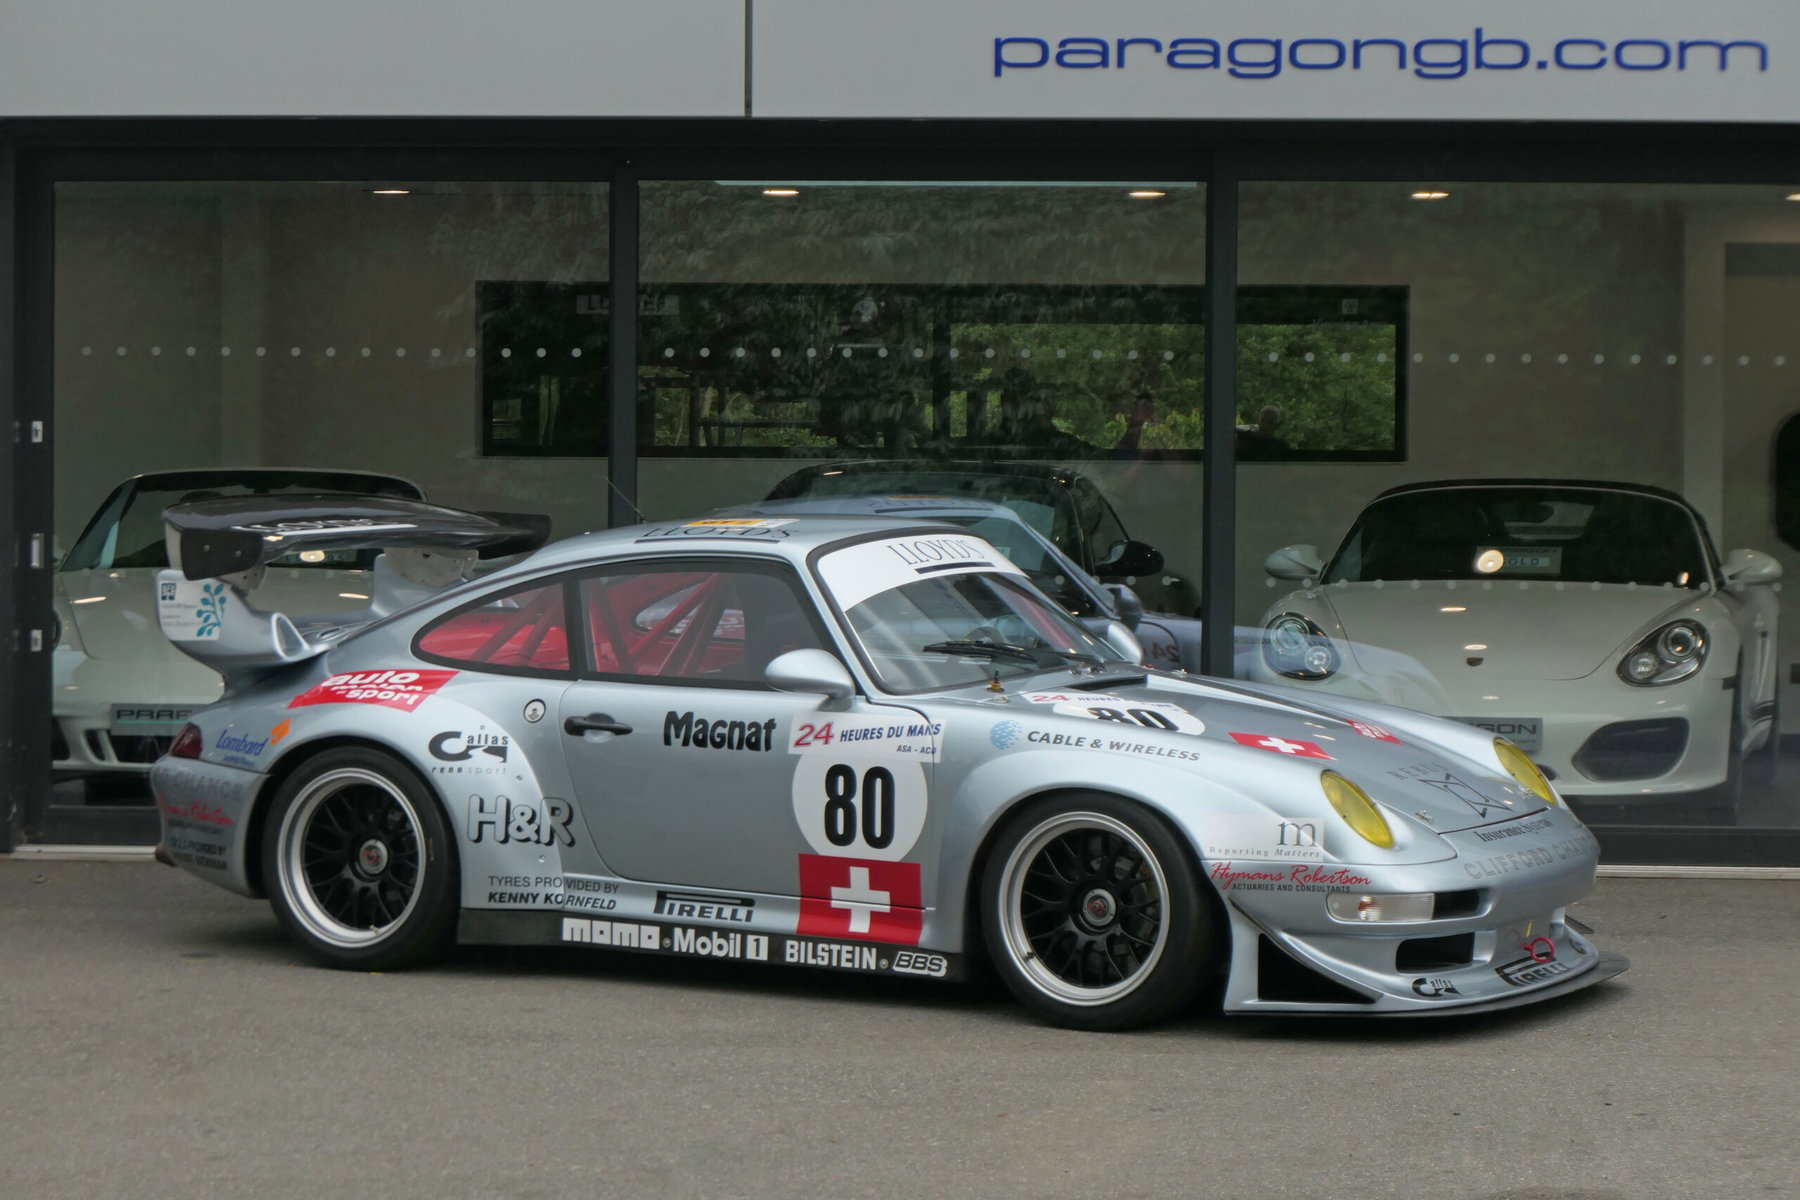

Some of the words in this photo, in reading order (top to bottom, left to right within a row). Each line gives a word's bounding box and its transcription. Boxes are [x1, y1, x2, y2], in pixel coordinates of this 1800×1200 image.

[993, 27, 1769, 79] paragongb.com
[321, 670, 420, 688] auto
[345, 689, 419, 705] sport
[663, 710, 777, 752] Magnat
[1087, 706, 1180, 732] 80
[215, 728, 270, 757] Lombard
[793, 722, 834, 748] 24
[840, 726, 884, 743] HEURES
[886, 725, 905, 740] DU
[906, 723, 942, 738] MANS
[1027, 730, 1085, 748] CABLE
[1089, 738, 1103, 749] &
[1108, 740, 1201, 761] WIRELESS
[897, 744, 913, 754] ASA
[824, 763, 896, 850] 80
[466, 793, 577, 848] H&R
[1474, 822, 1525, 843] Insurance
[1276, 821, 1318, 848] m
[1209, 846, 1269, 857] Reporting
[1274, 848, 1321, 859] Matters
[1463, 847, 1554, 880] CLIFFORD
[488, 875, 531, 889] TYRES
[534, 876, 600, 892] PROVIDED
[601, 882, 619, 894] BY
[1211, 861, 1286, 890] Hymans
[1287, 864, 1372, 886] Robertson
[1232, 882, 1275, 892] ACTUARIES
[1277, 884, 1294, 893] AND
[1295, 884, 1351, 894] CONSULTANTS
[487, 891, 540, 905] KENNY
[543, 893, 617, 911] KORNFELD
[653, 889, 757, 923] PIRELLI
[673, 926, 742, 959] Mobil
[746, 934, 769, 961] 1
[784, 939, 877, 971] BILSTEIN
[892, 950, 948, 976] BBS
